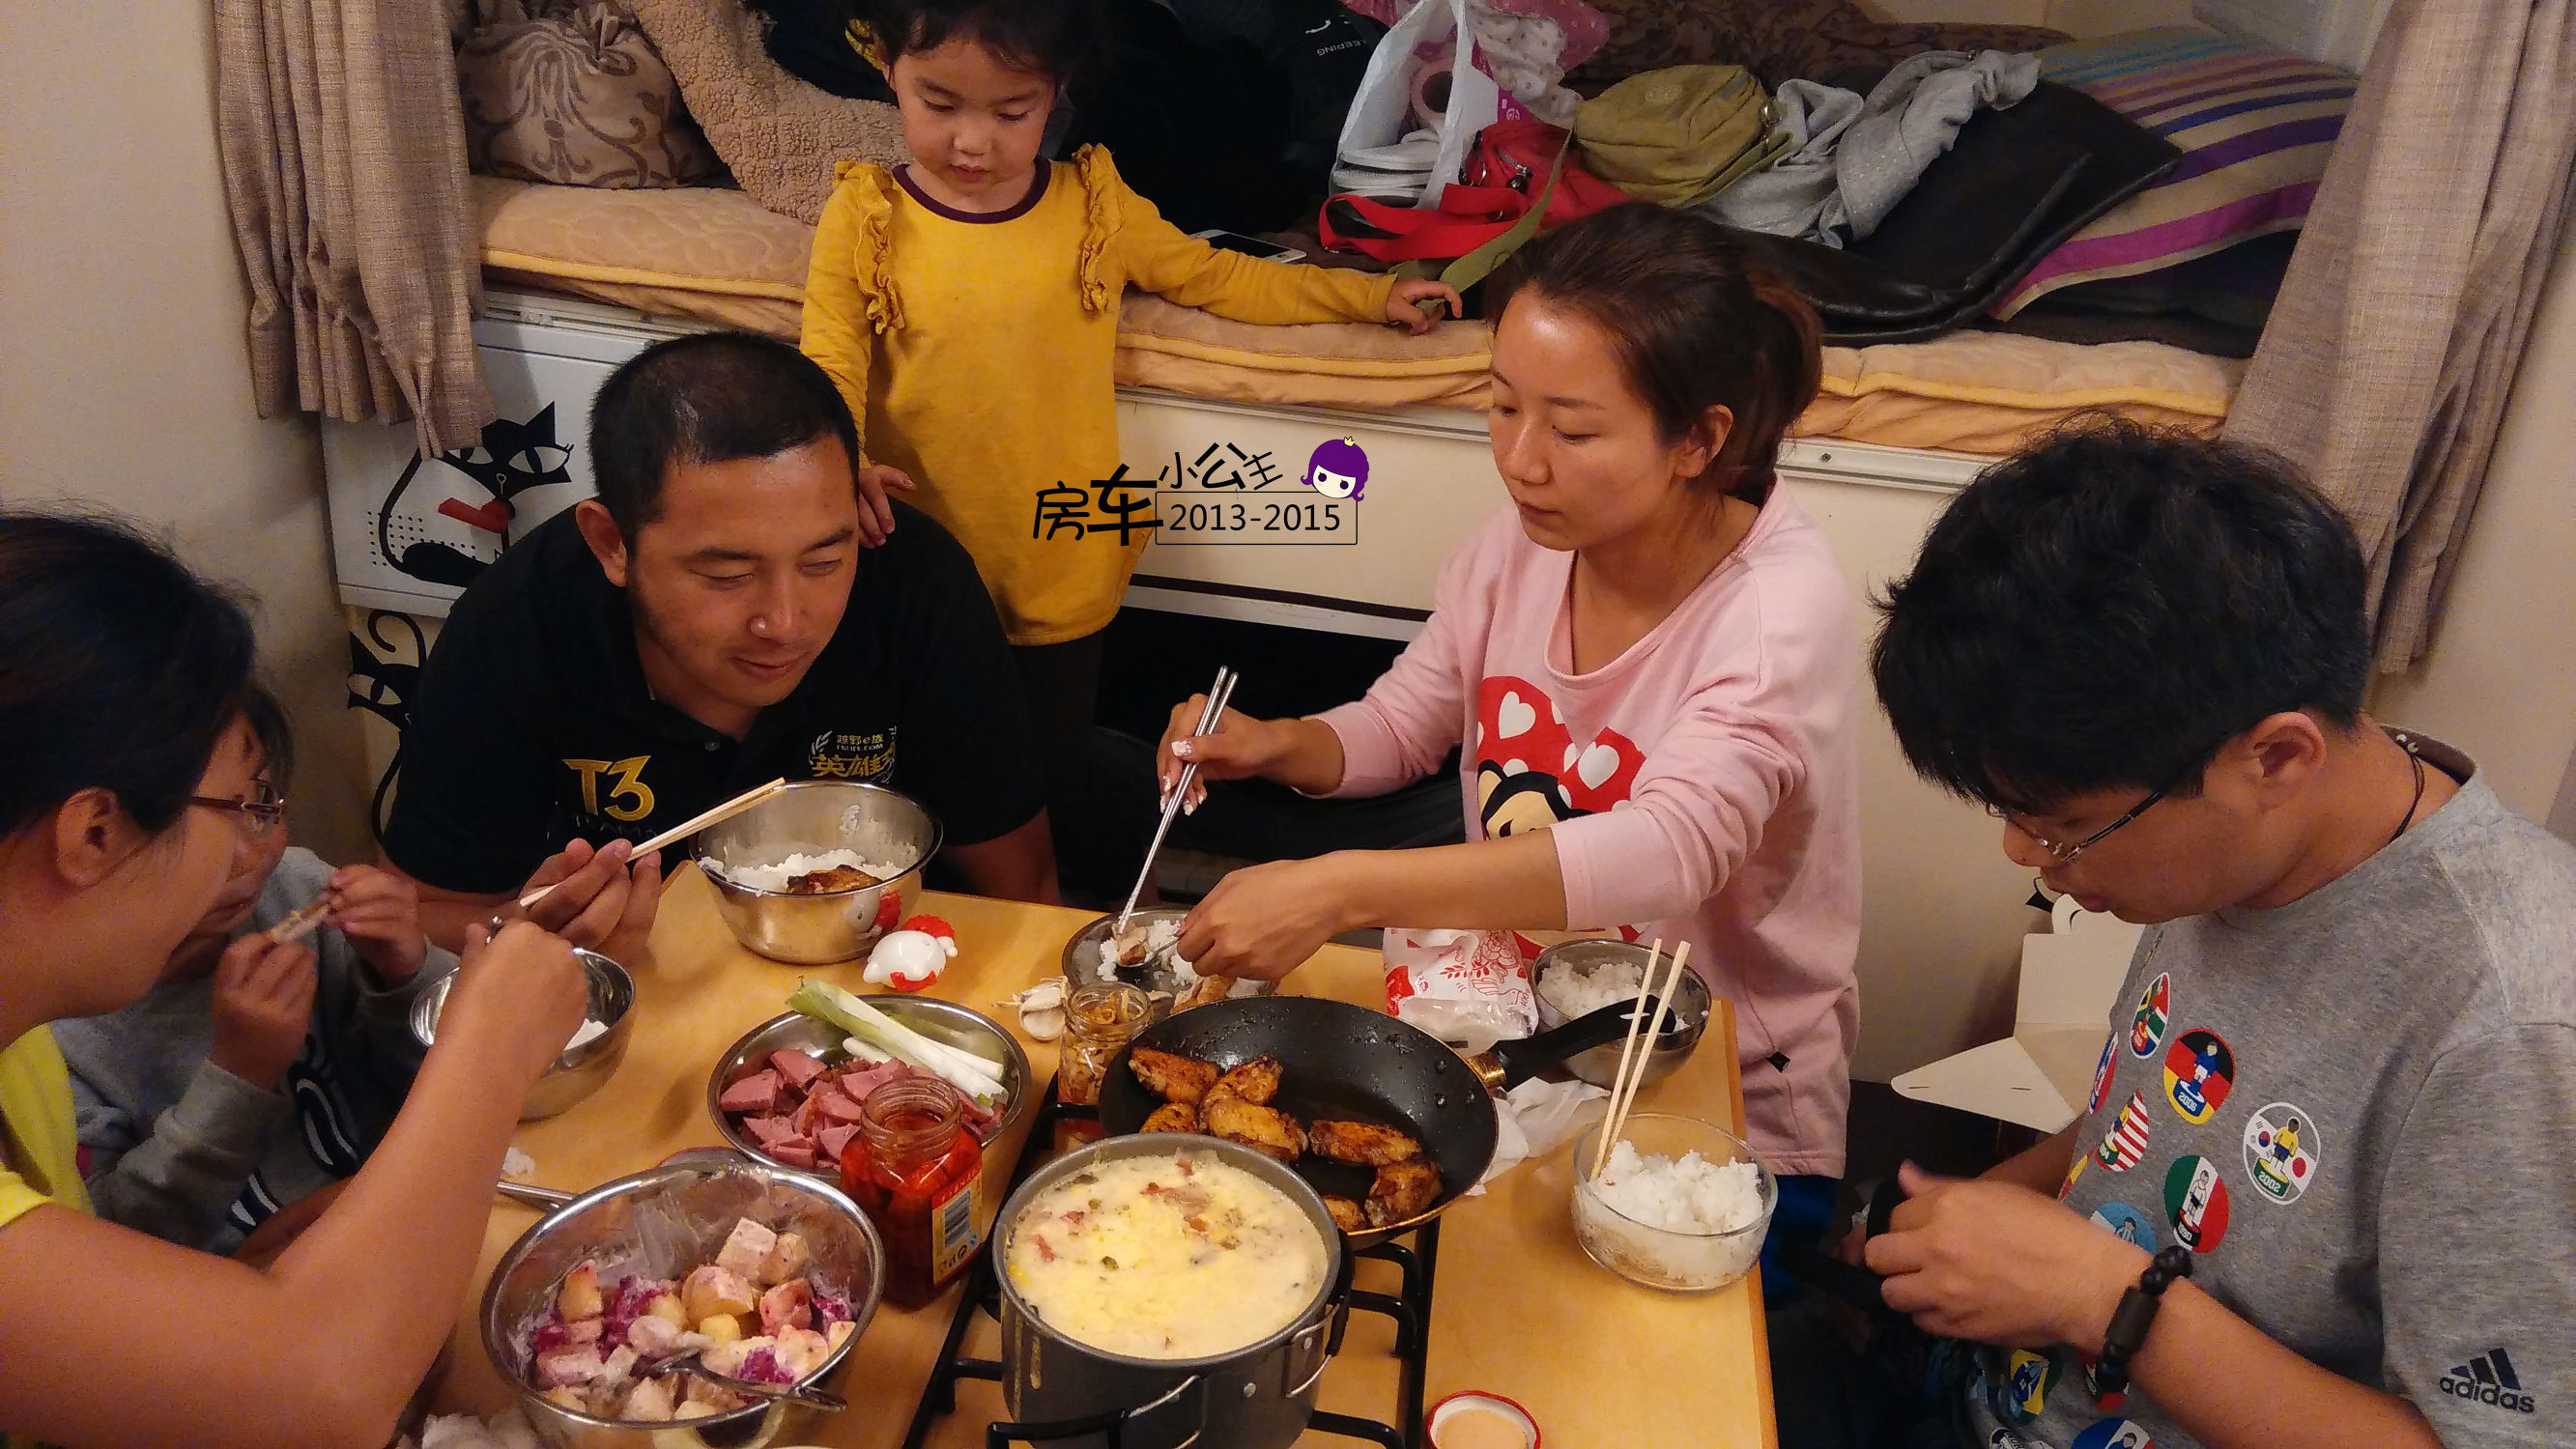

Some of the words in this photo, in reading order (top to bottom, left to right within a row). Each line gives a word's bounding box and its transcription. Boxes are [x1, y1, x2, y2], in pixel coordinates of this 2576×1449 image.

[561, 754, 655, 821] T3
[2258, 1171, 2281, 1193] 2002
[2439, 1377, 2535, 1413] adidas
